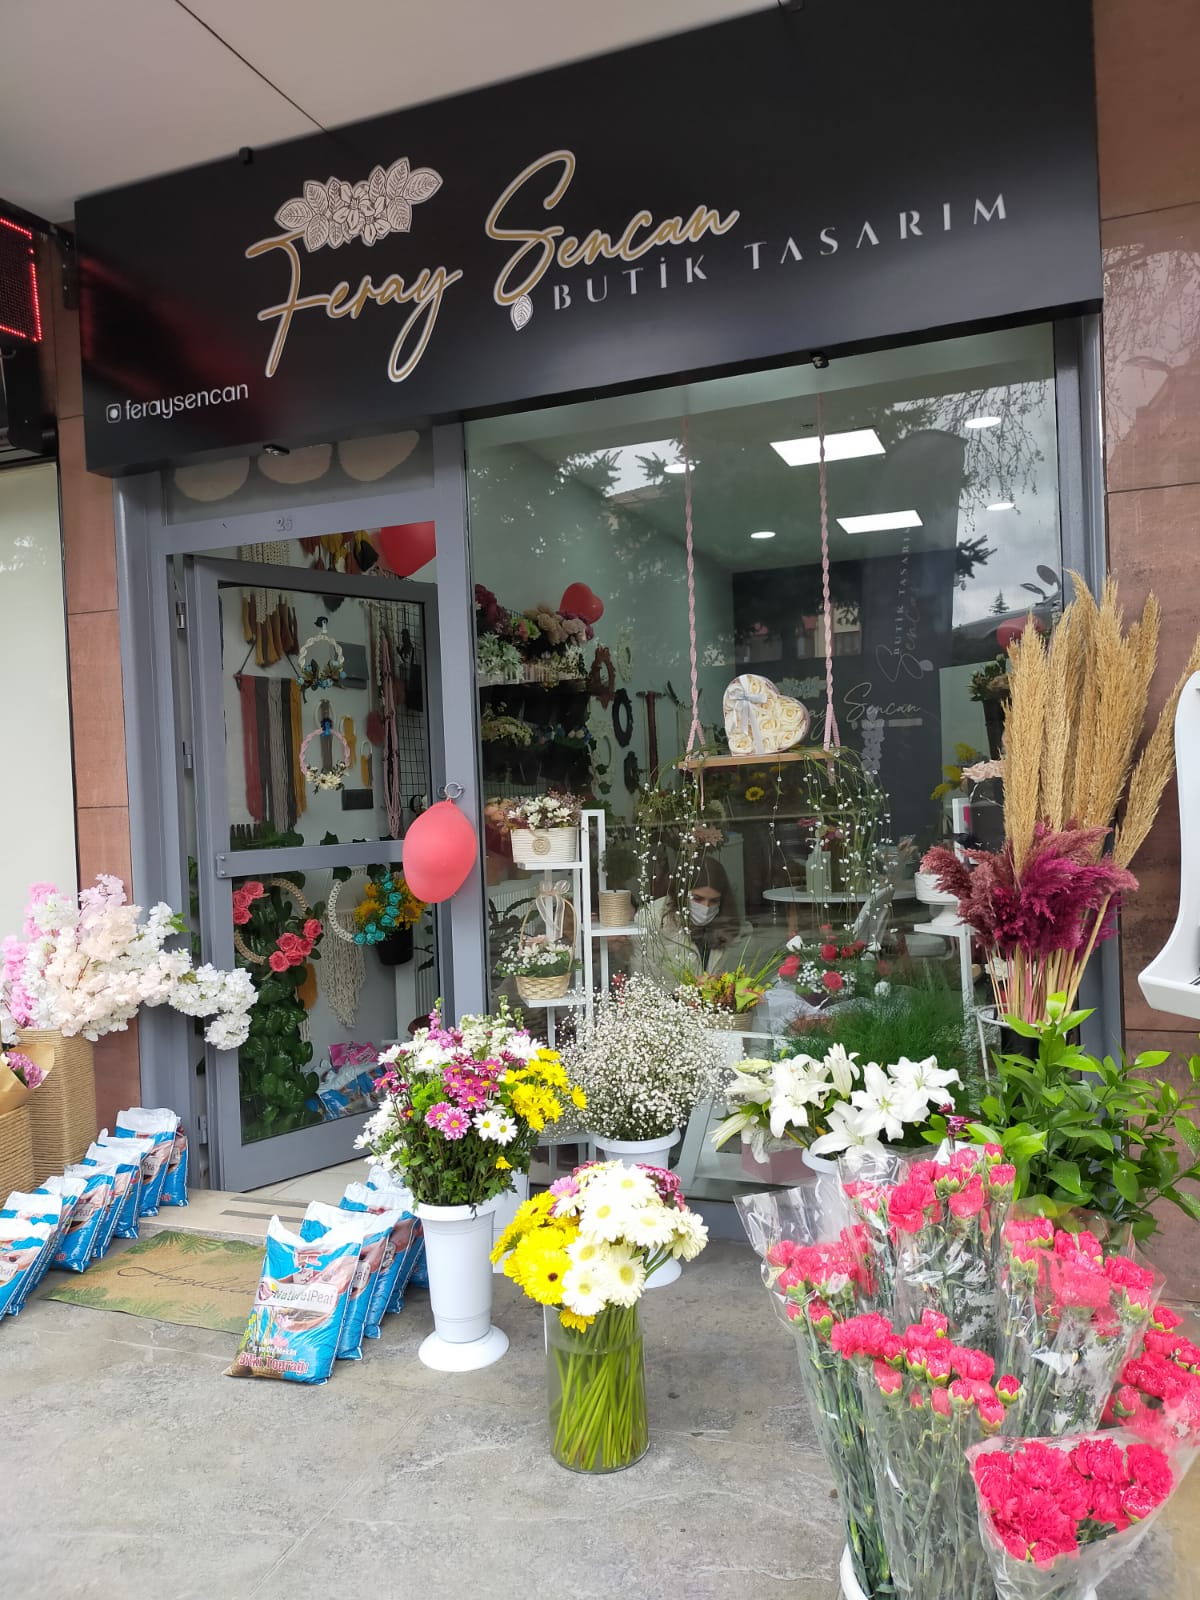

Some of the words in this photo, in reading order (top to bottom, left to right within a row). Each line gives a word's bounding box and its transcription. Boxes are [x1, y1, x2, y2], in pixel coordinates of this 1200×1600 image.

[245, 231, 464, 383] Feray
[484, 149, 740, 307] Sencan
[553, 253, 709, 311] BUTİK
[743, 192, 1009, 272] TASARIM
[125, 383, 249, 420] feraysencan
